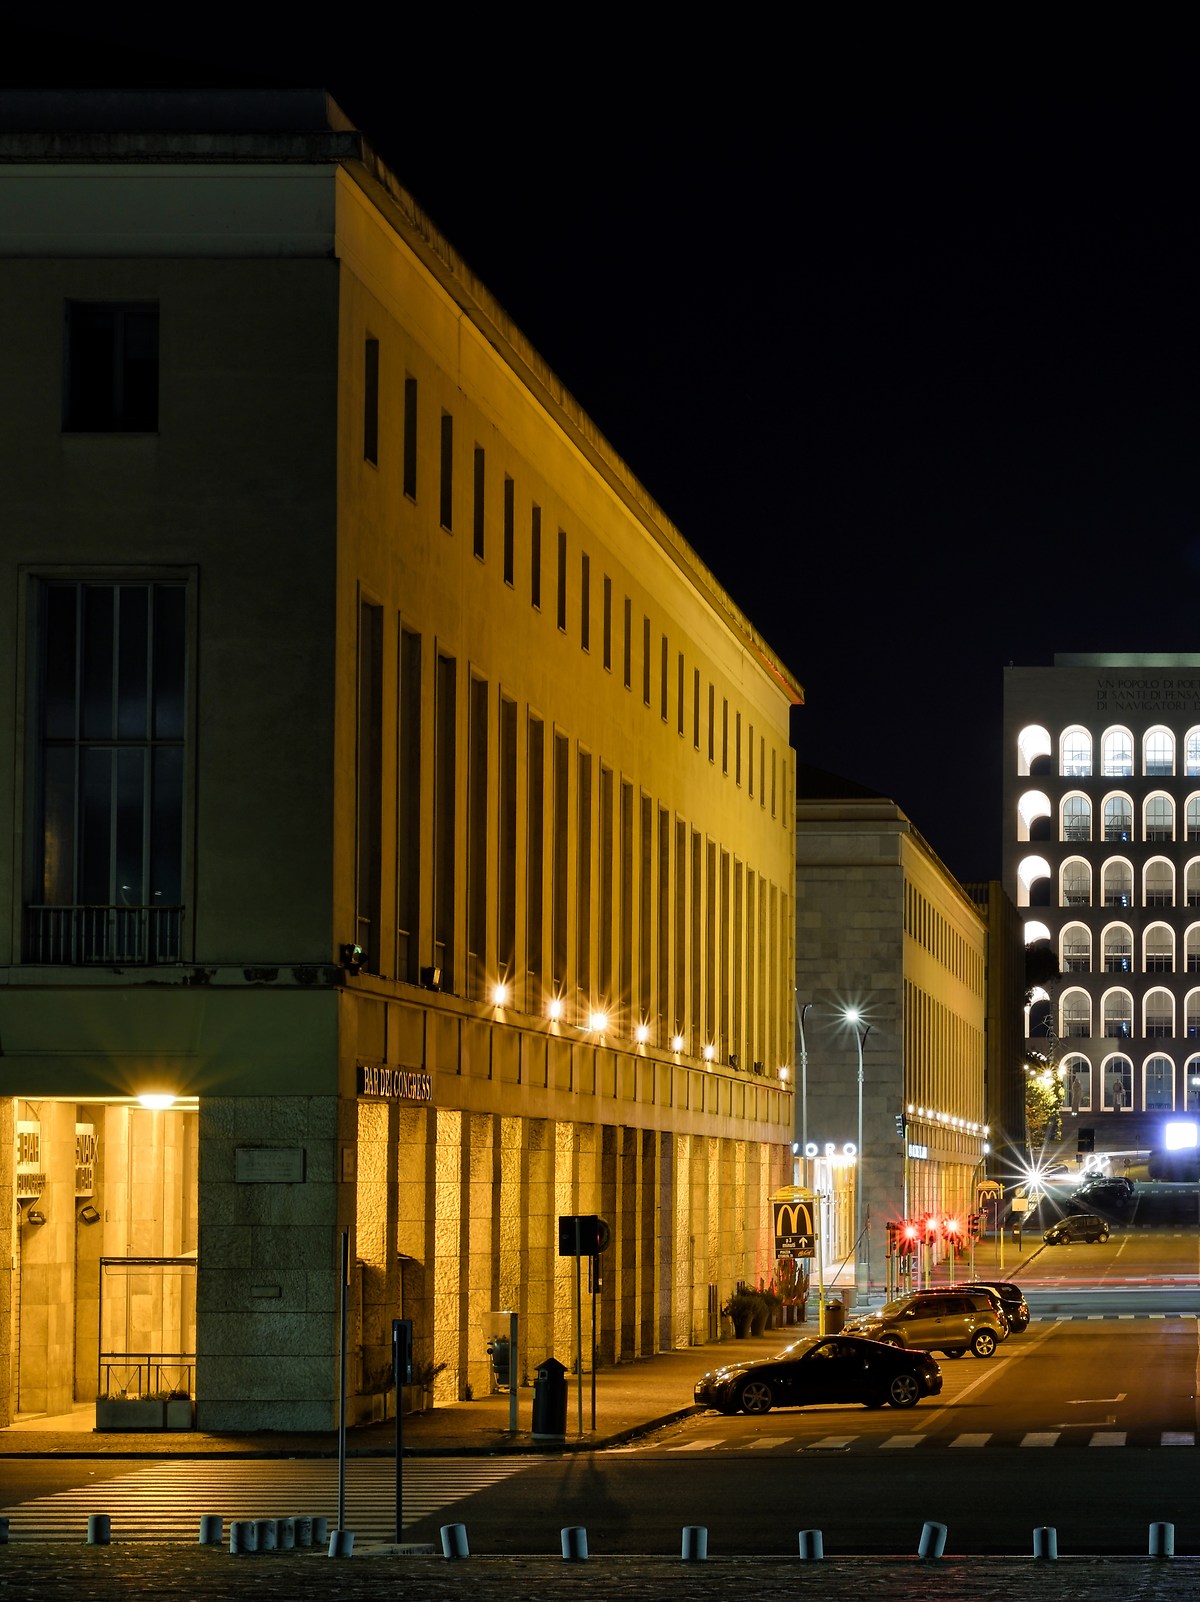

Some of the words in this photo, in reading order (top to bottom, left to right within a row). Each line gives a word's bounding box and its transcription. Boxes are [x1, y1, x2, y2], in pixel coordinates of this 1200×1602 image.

[1118, 680, 1160, 689] POPOLO
[1163, 680, 1174, 689] DI
[1097, 691, 1107, 700] DI
[1112, 691, 1145, 700] SANTI
[1151, 691, 1161, 700] DI
[1097, 701, 1107, 711] DI
[1116, 701, 1186, 711] NAVIGATORI
[364, 1067, 379, 1095] BAR
[380, 1069, 392, 1097] DEI
[393, 1071, 433, 1100] CONGRESSI
